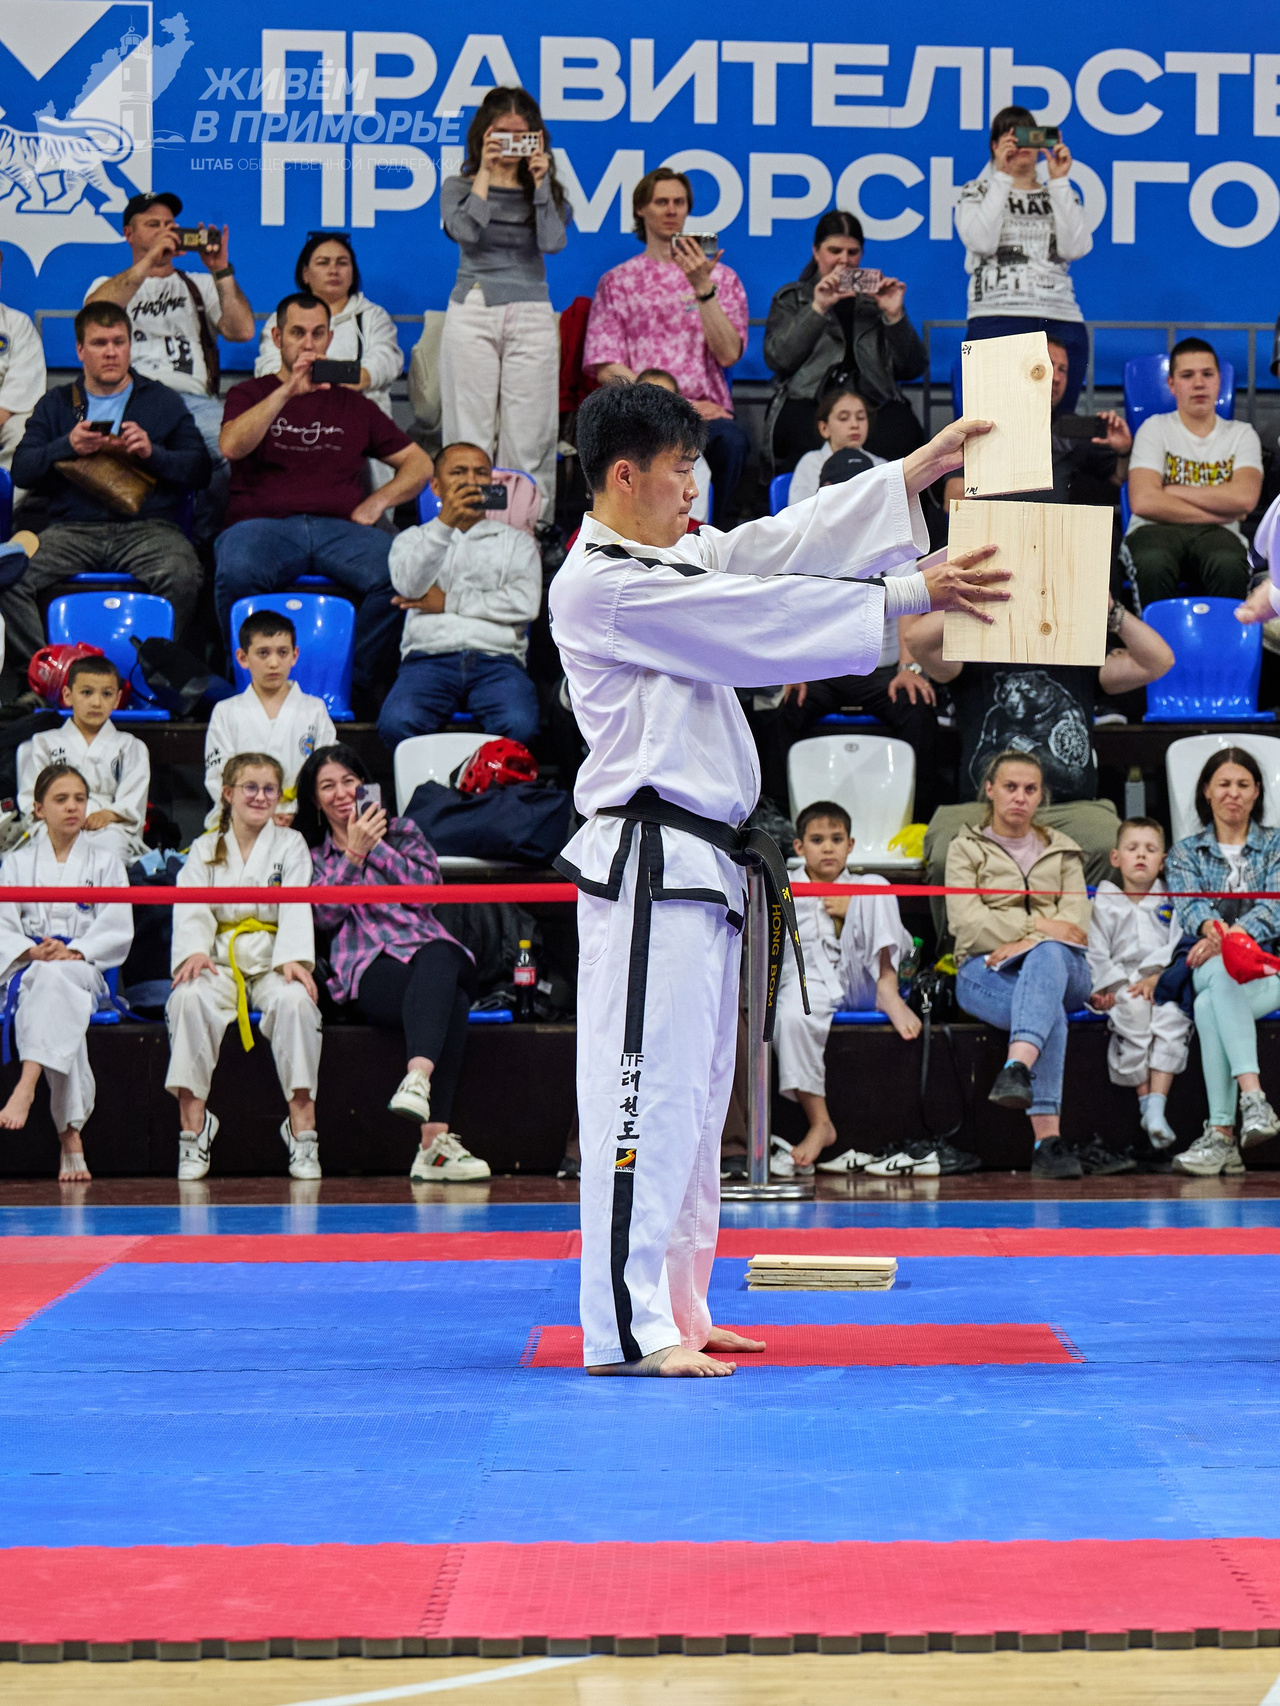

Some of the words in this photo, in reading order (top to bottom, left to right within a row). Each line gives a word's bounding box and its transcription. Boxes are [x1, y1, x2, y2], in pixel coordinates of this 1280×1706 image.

[771, 904, 782, 957] HONG
[767, 964, 778, 1007] BOM
[620, 1053, 645, 1067] ITF
